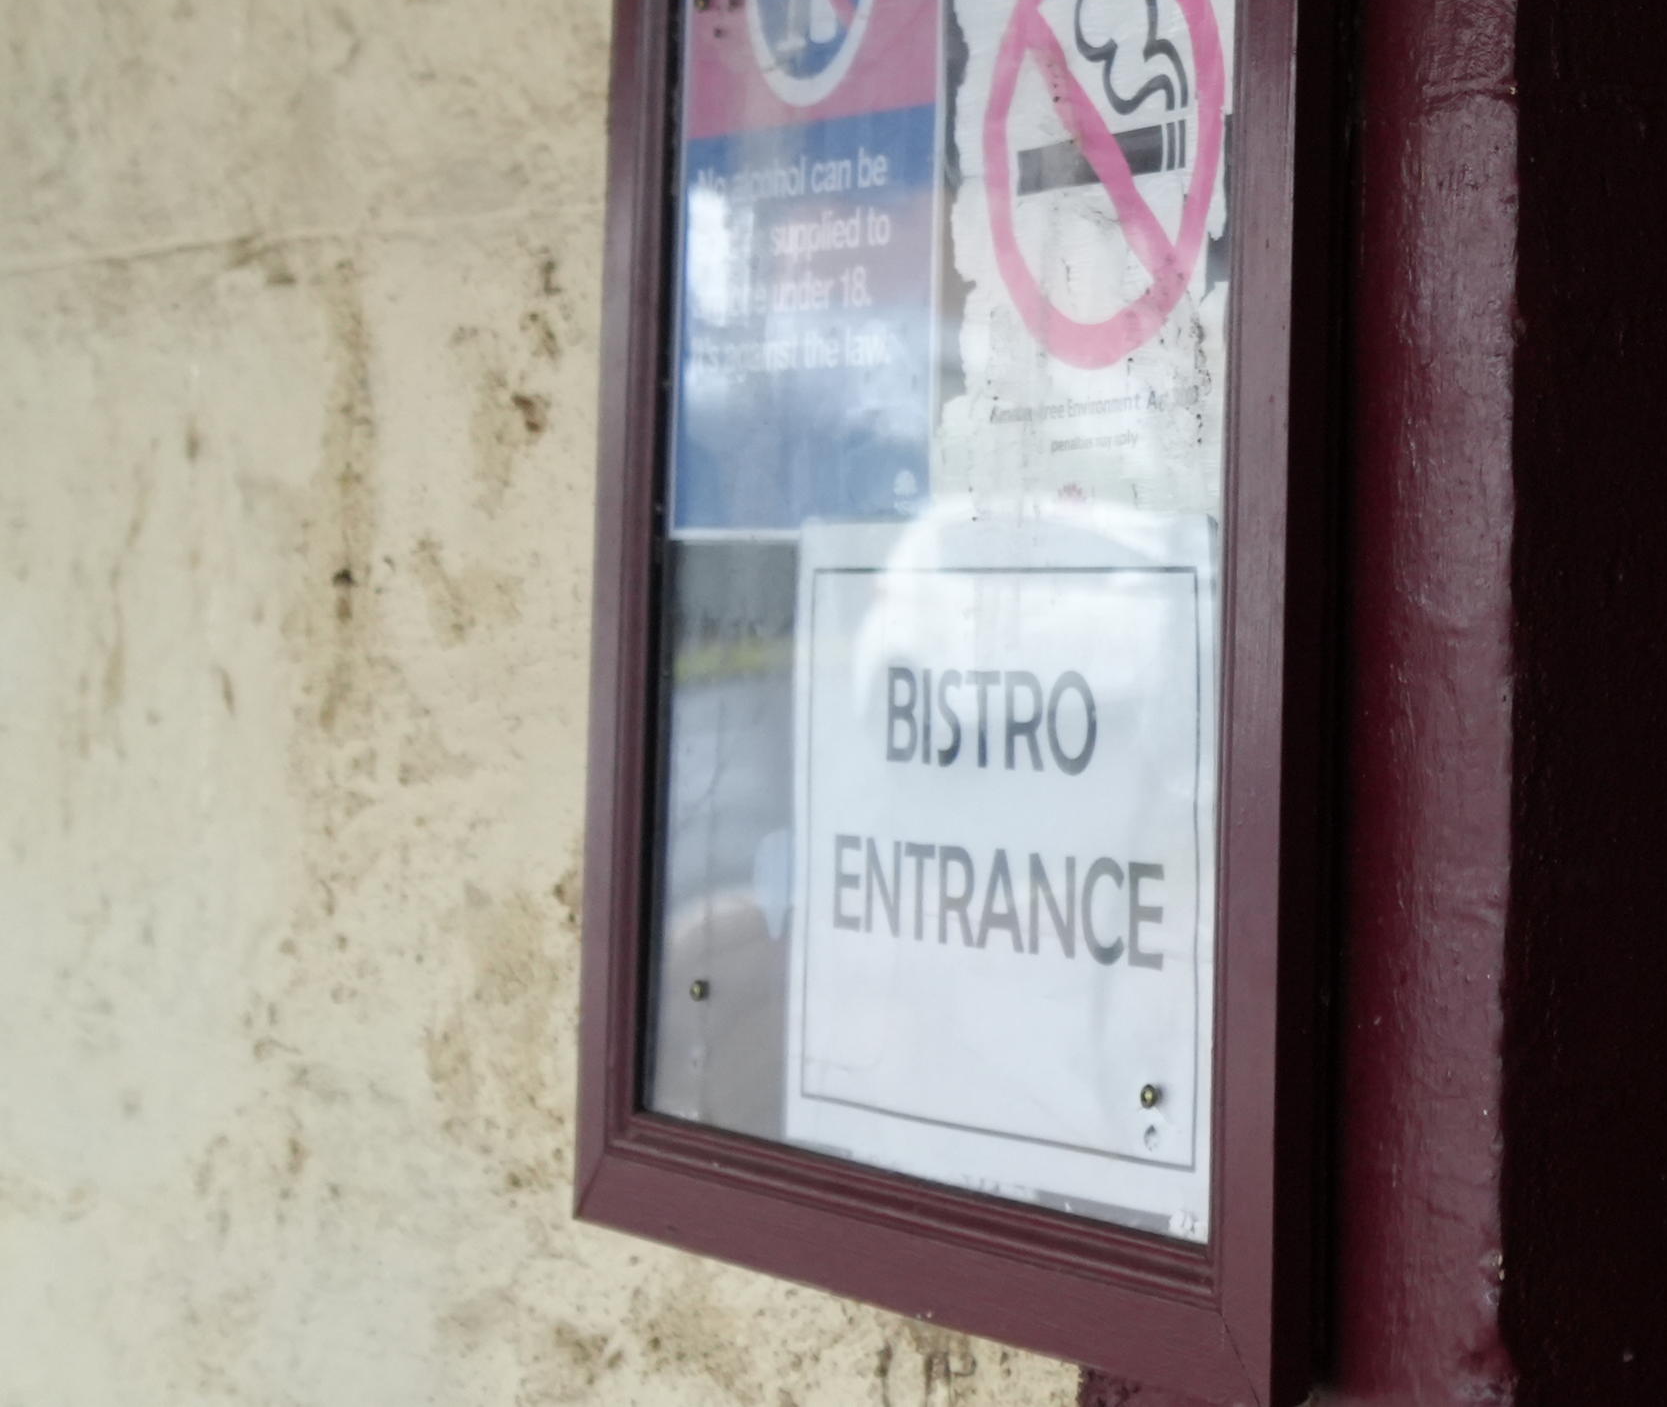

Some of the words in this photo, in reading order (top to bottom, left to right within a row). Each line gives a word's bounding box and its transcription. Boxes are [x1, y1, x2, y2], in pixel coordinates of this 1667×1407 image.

[811, 159, 852, 194] can
[858, 146, 889, 189] be
[769, 207, 860, 261] supplied
[867, 206, 892, 247] to
[772, 271, 834, 314] under
[839, 265, 873, 309] 18.
[803, 327, 840, 369] the
[884, 666, 1098, 776] BISTRO
[832, 834, 1165, 971] ENTRANCE
